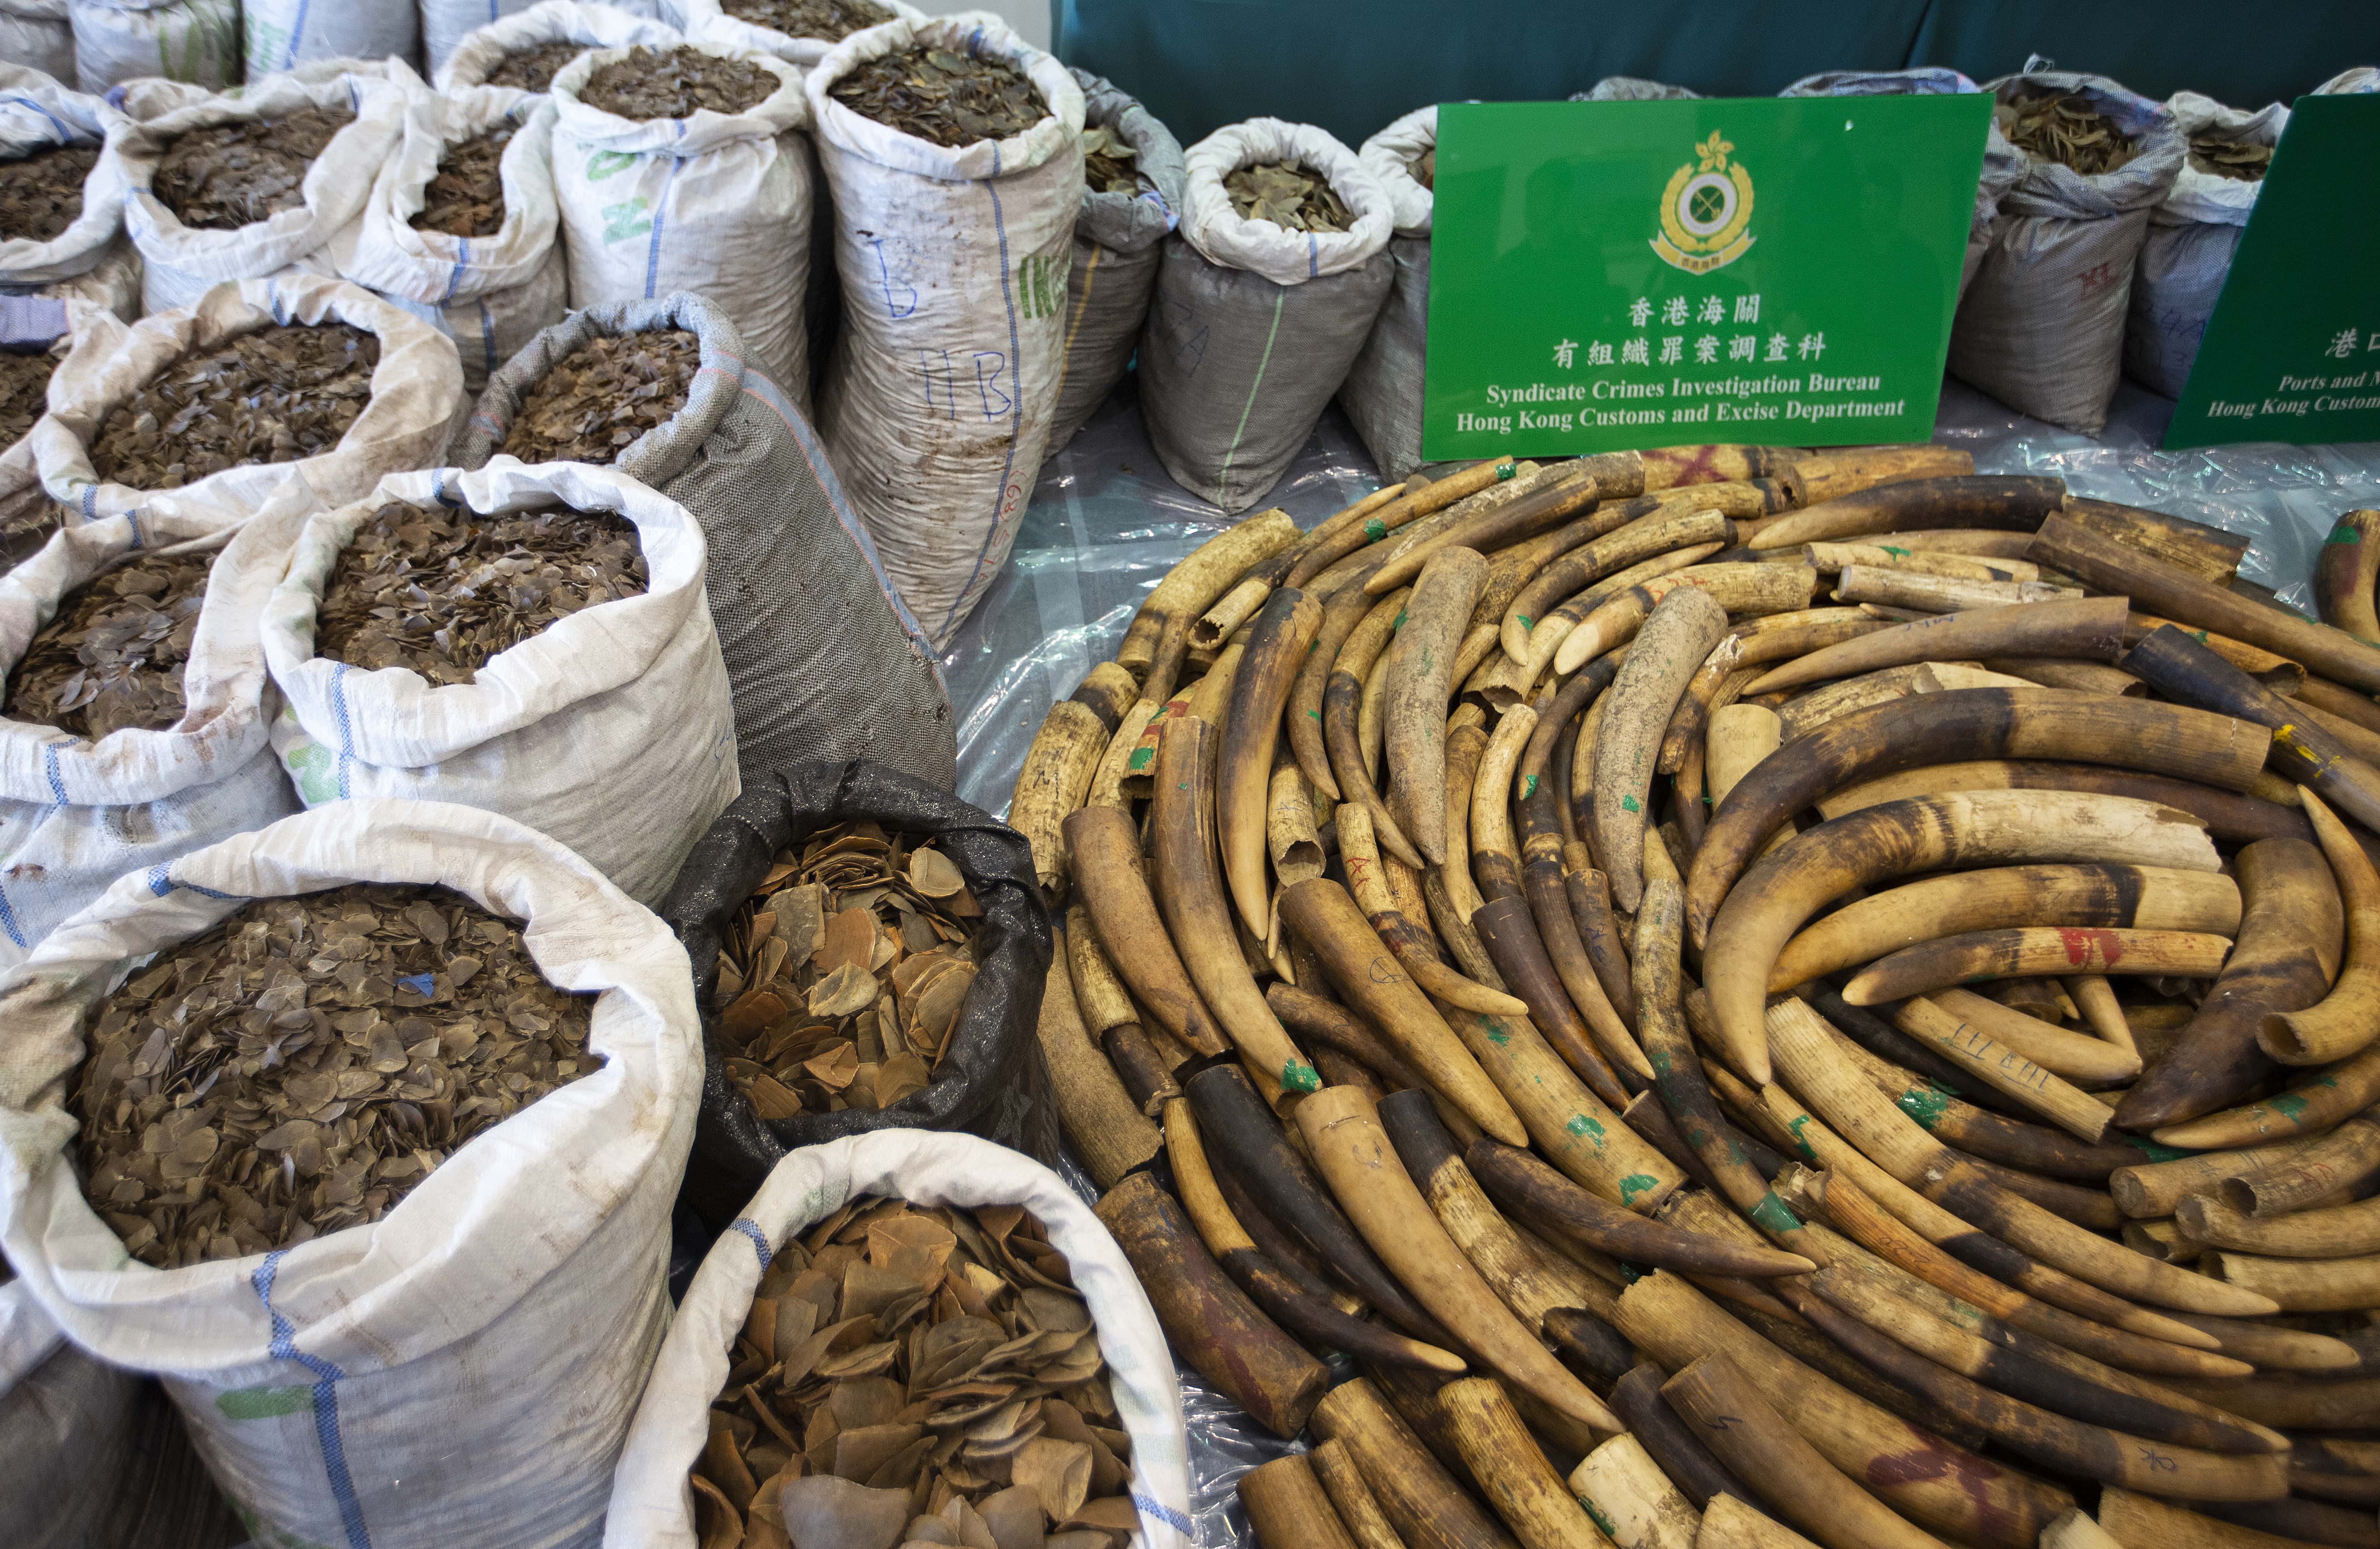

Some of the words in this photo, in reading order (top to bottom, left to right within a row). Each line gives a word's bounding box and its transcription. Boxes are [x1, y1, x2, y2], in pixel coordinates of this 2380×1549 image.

[1628, 293, 1761, 327] 香港海關
[1552, 331, 1826, 369] 有組織罪案調查科
[1486, 382, 1586, 409] Syndicate
[1592, 380, 1665, 399] Crimes
[1672, 374, 1801, 399] Investigation
[1808, 373, 1881, 392] Bureau
[2277, 375, 2326, 392] Ports
[2330, 371, 2368, 389] and
[1457, 412, 1512, 435] Hong
[1518, 410, 1573, 432] Kong
[1579, 408, 1666, 427] Customs
[1671, 403, 1710, 423] and
[1716, 401, 1780, 421] Excise
[1785, 398, 1906, 423] Department
[2206, 400, 2257, 420] Hong
[2260, 397, 2310, 416] Kong
